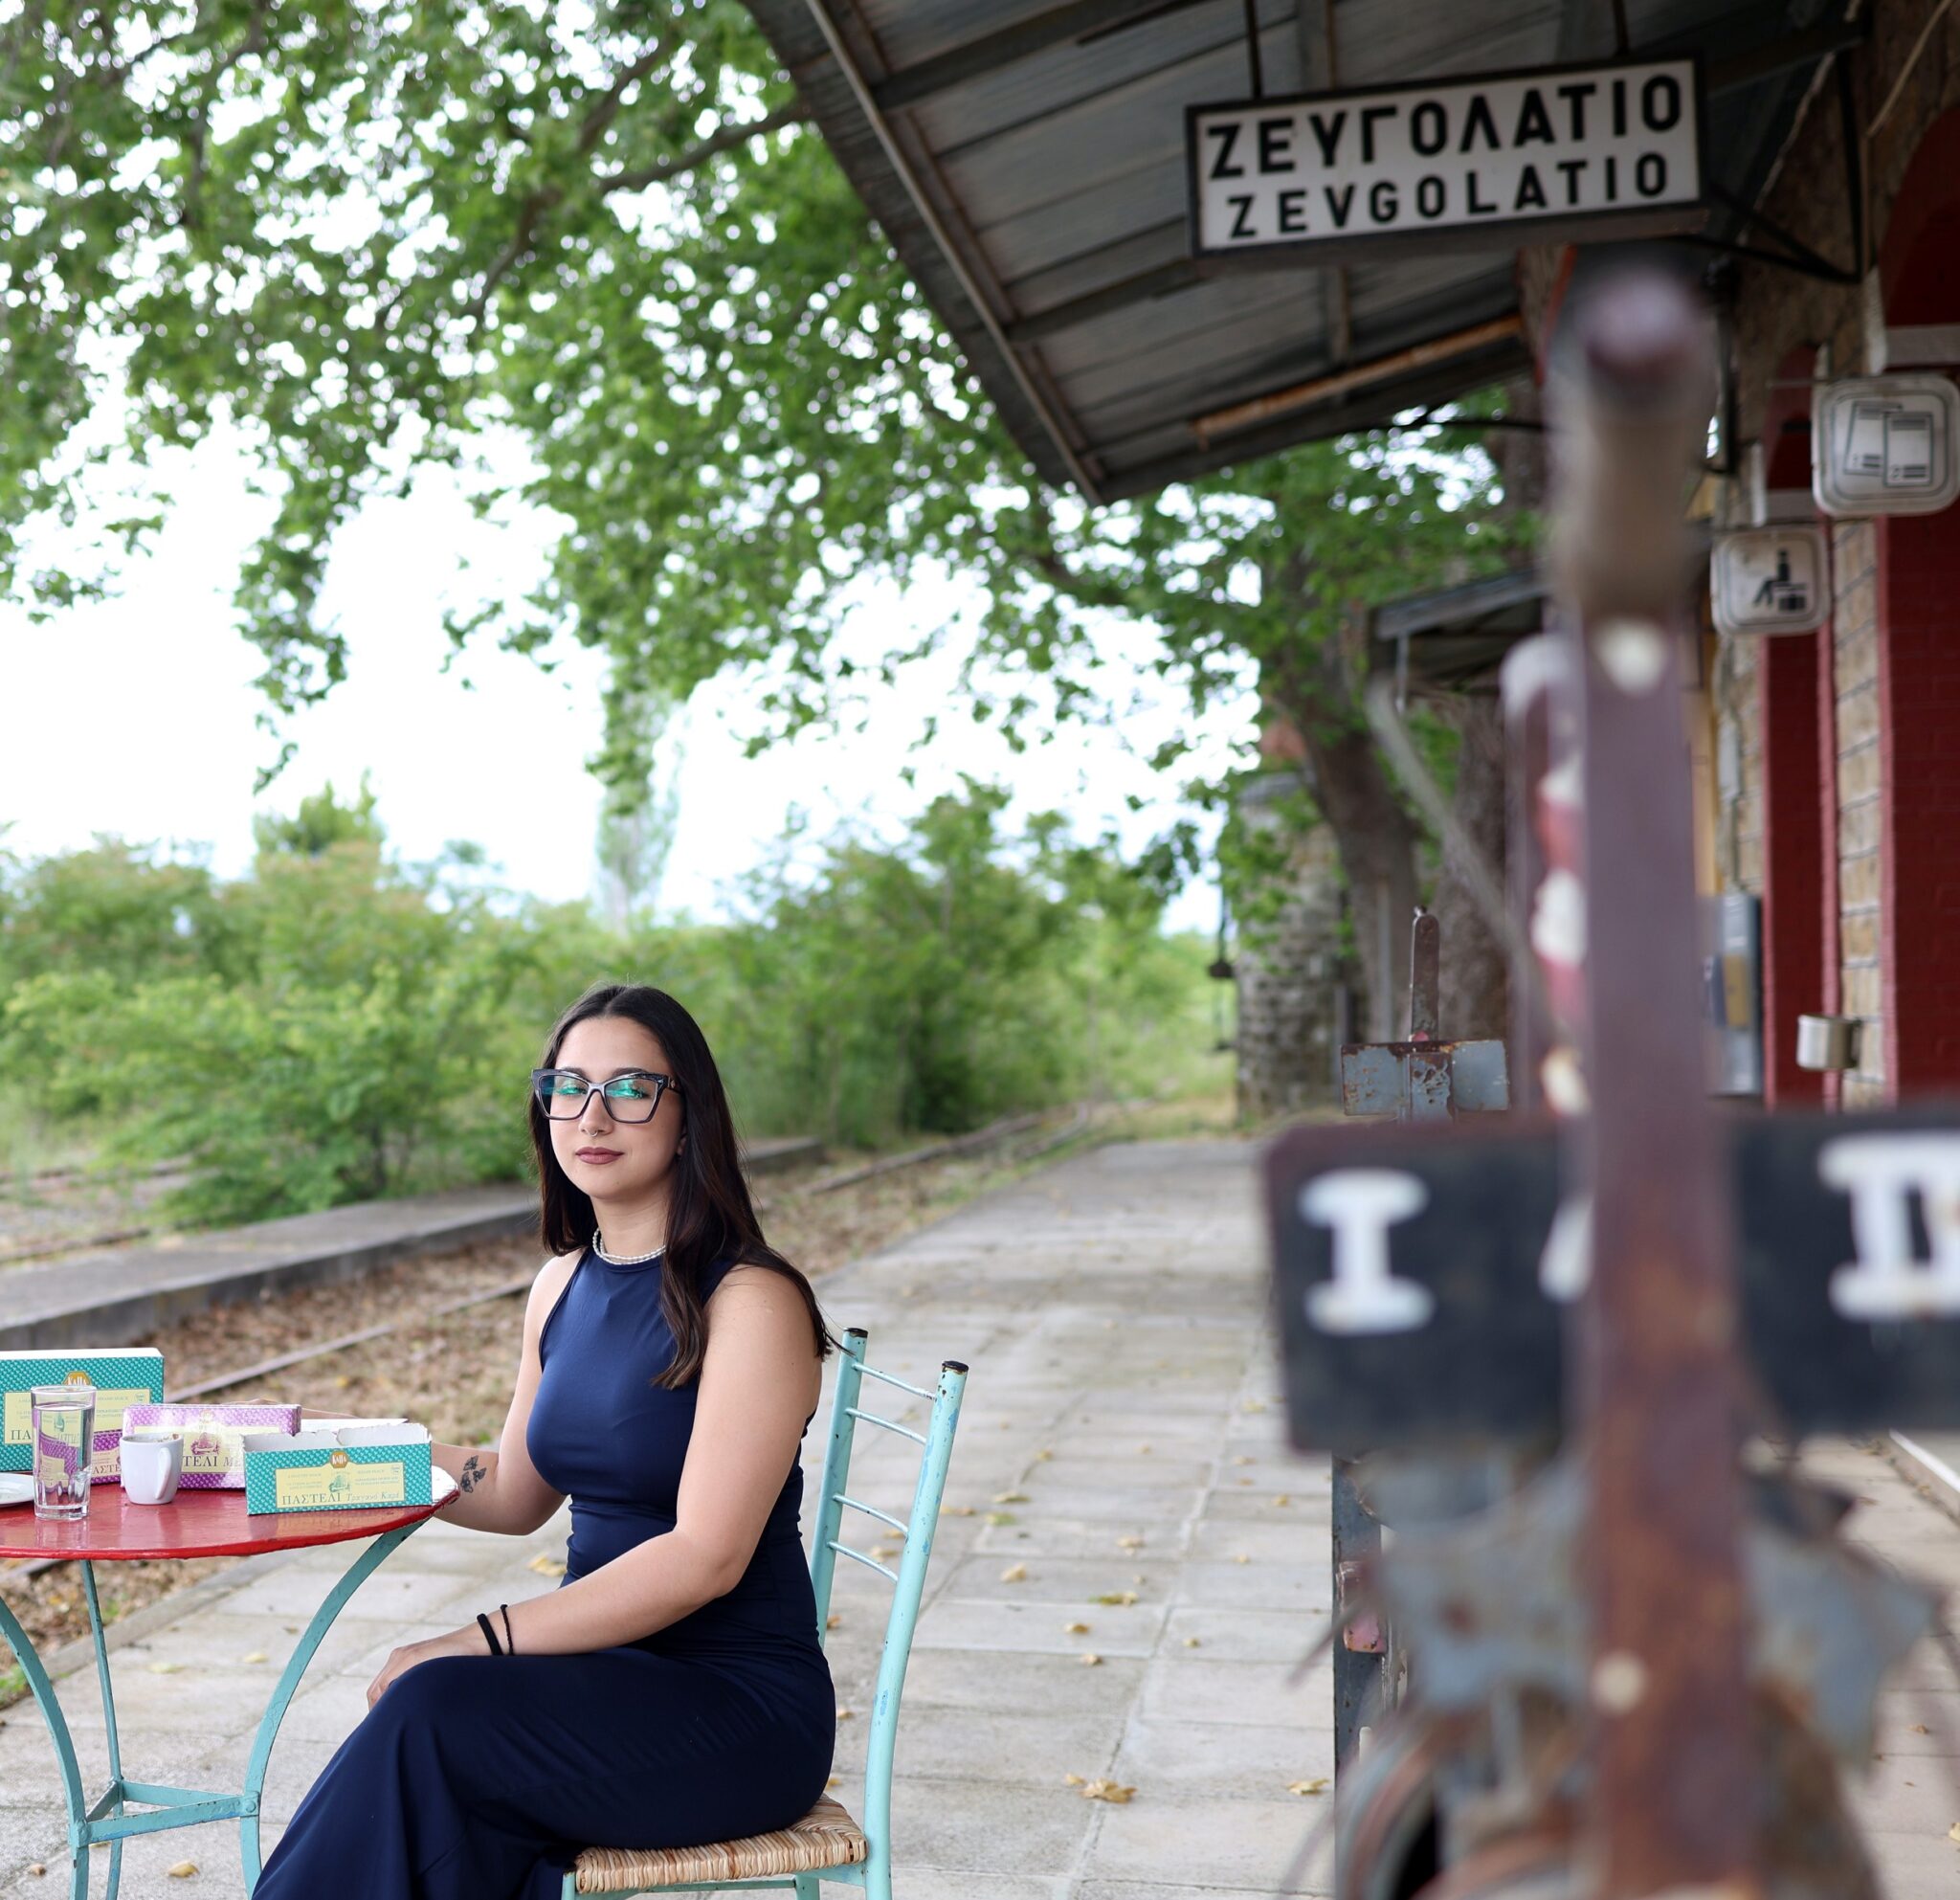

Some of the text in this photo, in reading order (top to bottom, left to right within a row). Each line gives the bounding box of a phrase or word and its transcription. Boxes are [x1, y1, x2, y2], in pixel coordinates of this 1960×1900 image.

[1208, 74, 1681, 180] ΖΕΥΓΟΛΑΤΙΟ
[1227, 151, 1666, 239] ZEVGOLATIO
[183, 1455, 218, 1467] ΤΕΛΙ
[92, 1464, 122, 1475] ΑΣΤΕ
[282, 1492, 341, 1506] ΠΑΣΤΕΛΙ
